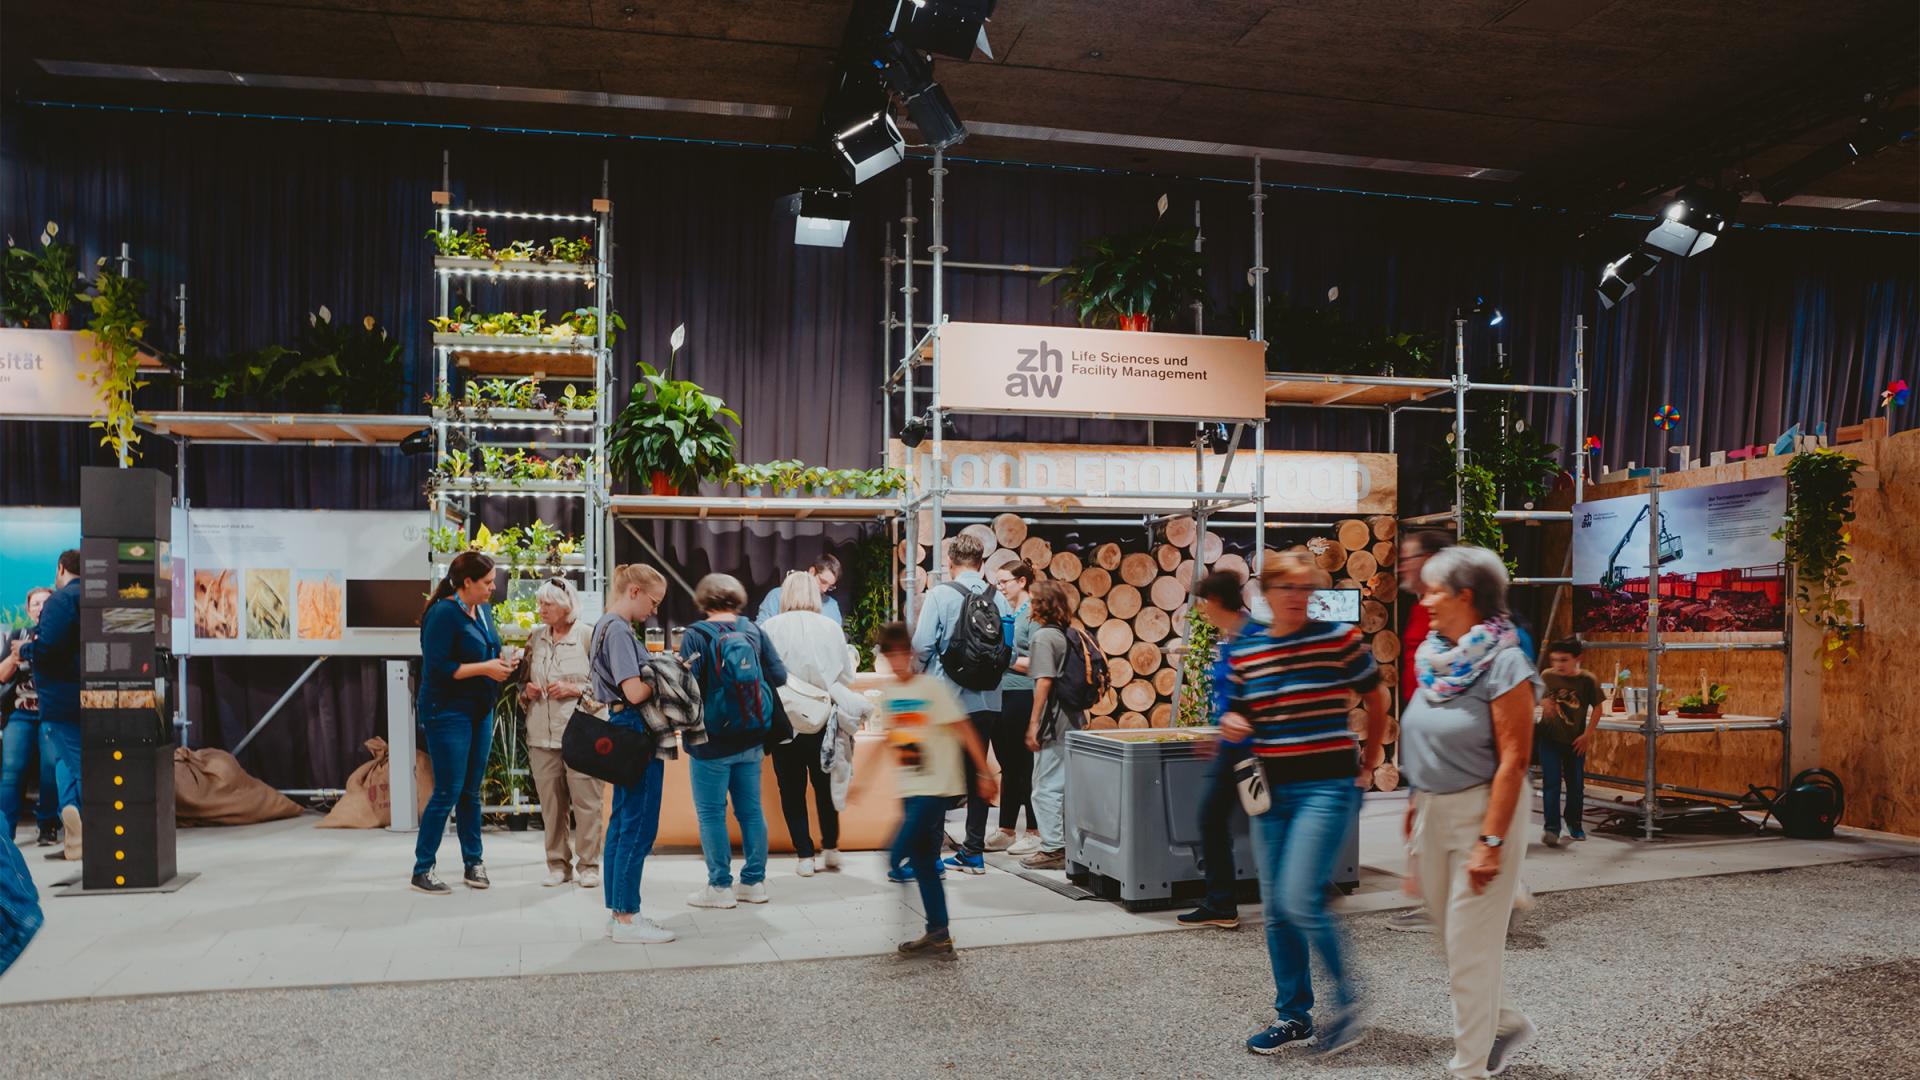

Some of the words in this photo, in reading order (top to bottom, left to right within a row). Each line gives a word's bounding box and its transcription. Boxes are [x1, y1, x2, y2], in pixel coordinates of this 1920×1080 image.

[1016, 340, 1063, 373] zh
[1071, 350, 1097, 362] Life
[1101, 351, 1160, 365] Sciences
[1163, 355, 1188, 367] und
[1071, 364, 1118, 378] Facility
[1122, 366, 1208, 381] Management
[1005, 372, 1063, 399] aw
